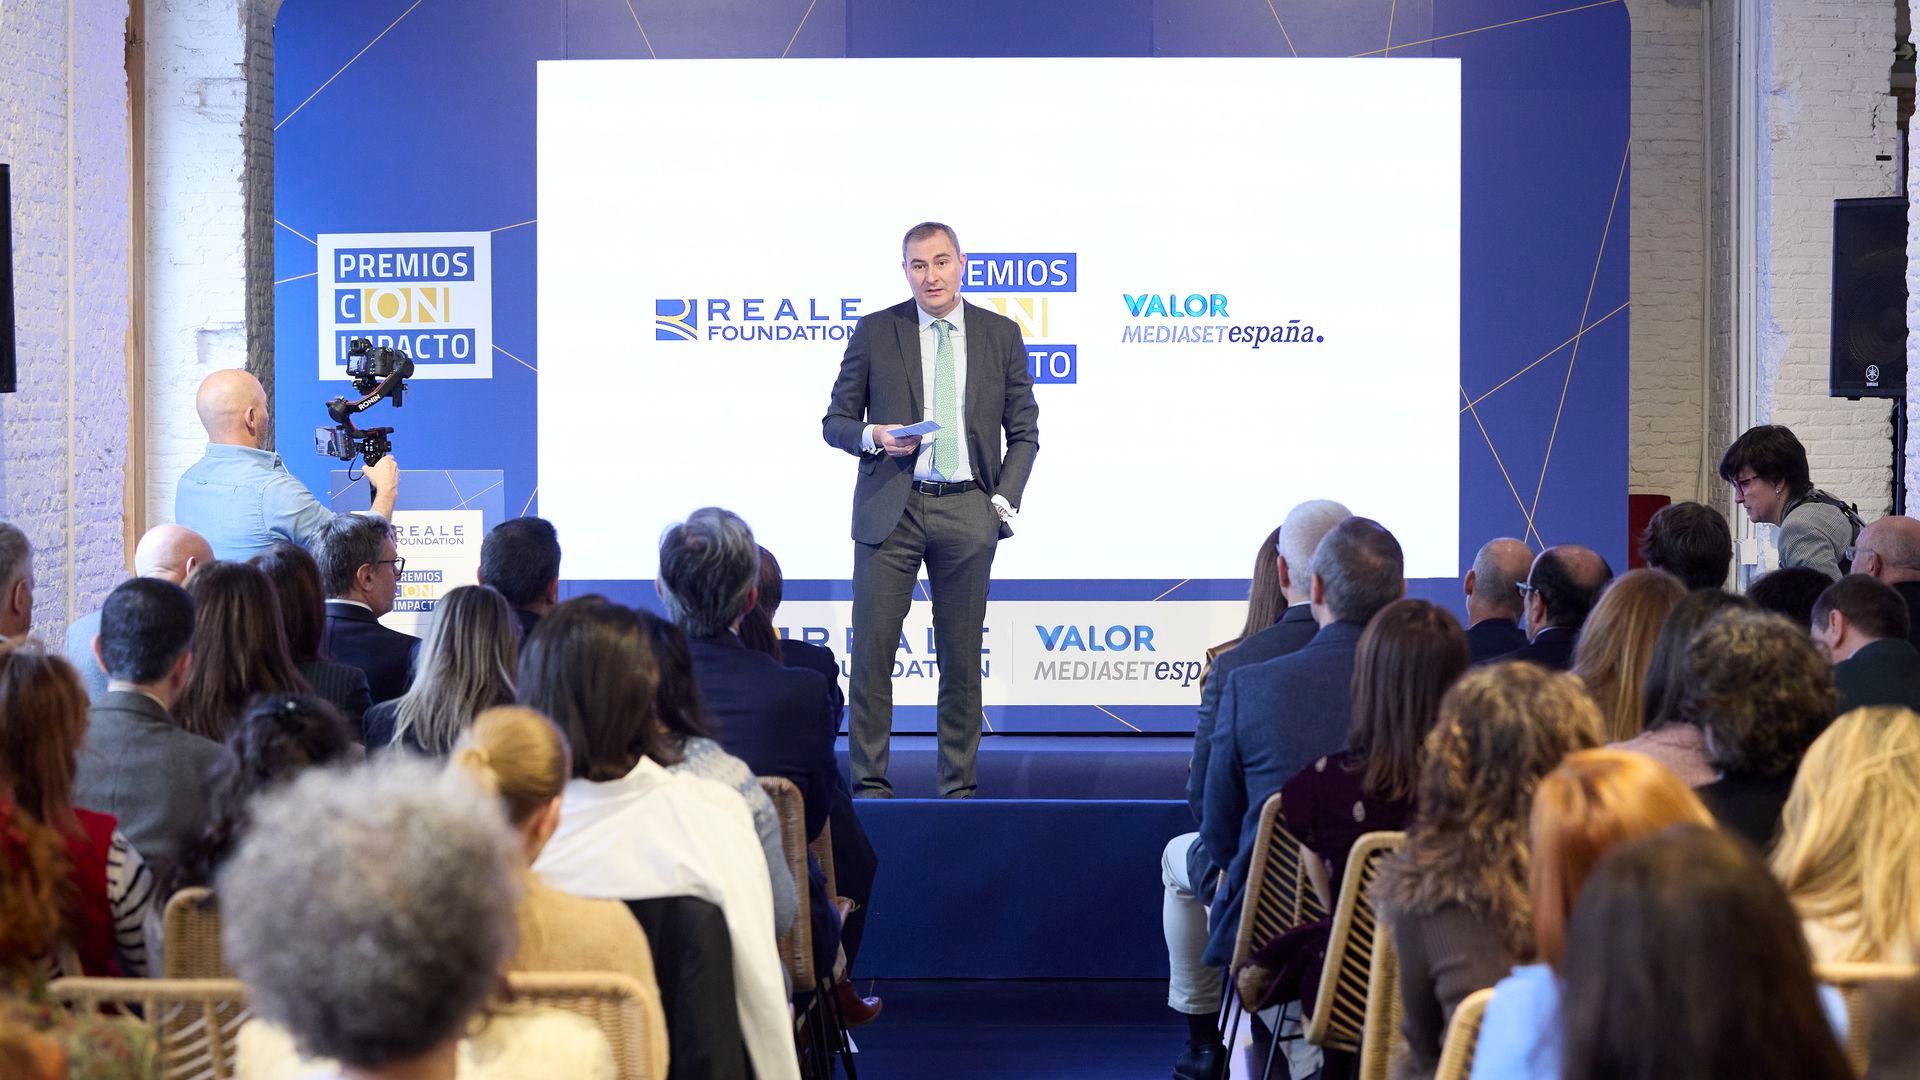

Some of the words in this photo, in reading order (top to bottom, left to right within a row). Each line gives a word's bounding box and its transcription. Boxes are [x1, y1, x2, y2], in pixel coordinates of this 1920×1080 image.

[339, 252, 468, 279] PREMIOS
[961, 259, 1069, 287] EMIOS
[340, 287, 445, 323] CON
[707, 298, 864, 321] REALE
[1122, 293, 1230, 318] VALOR
[358, 393, 381, 411] RONIN
[396, 525, 464, 537] REALE
[400, 572, 441, 582] REMIOS
[1035, 624, 1156, 652] VALOR
